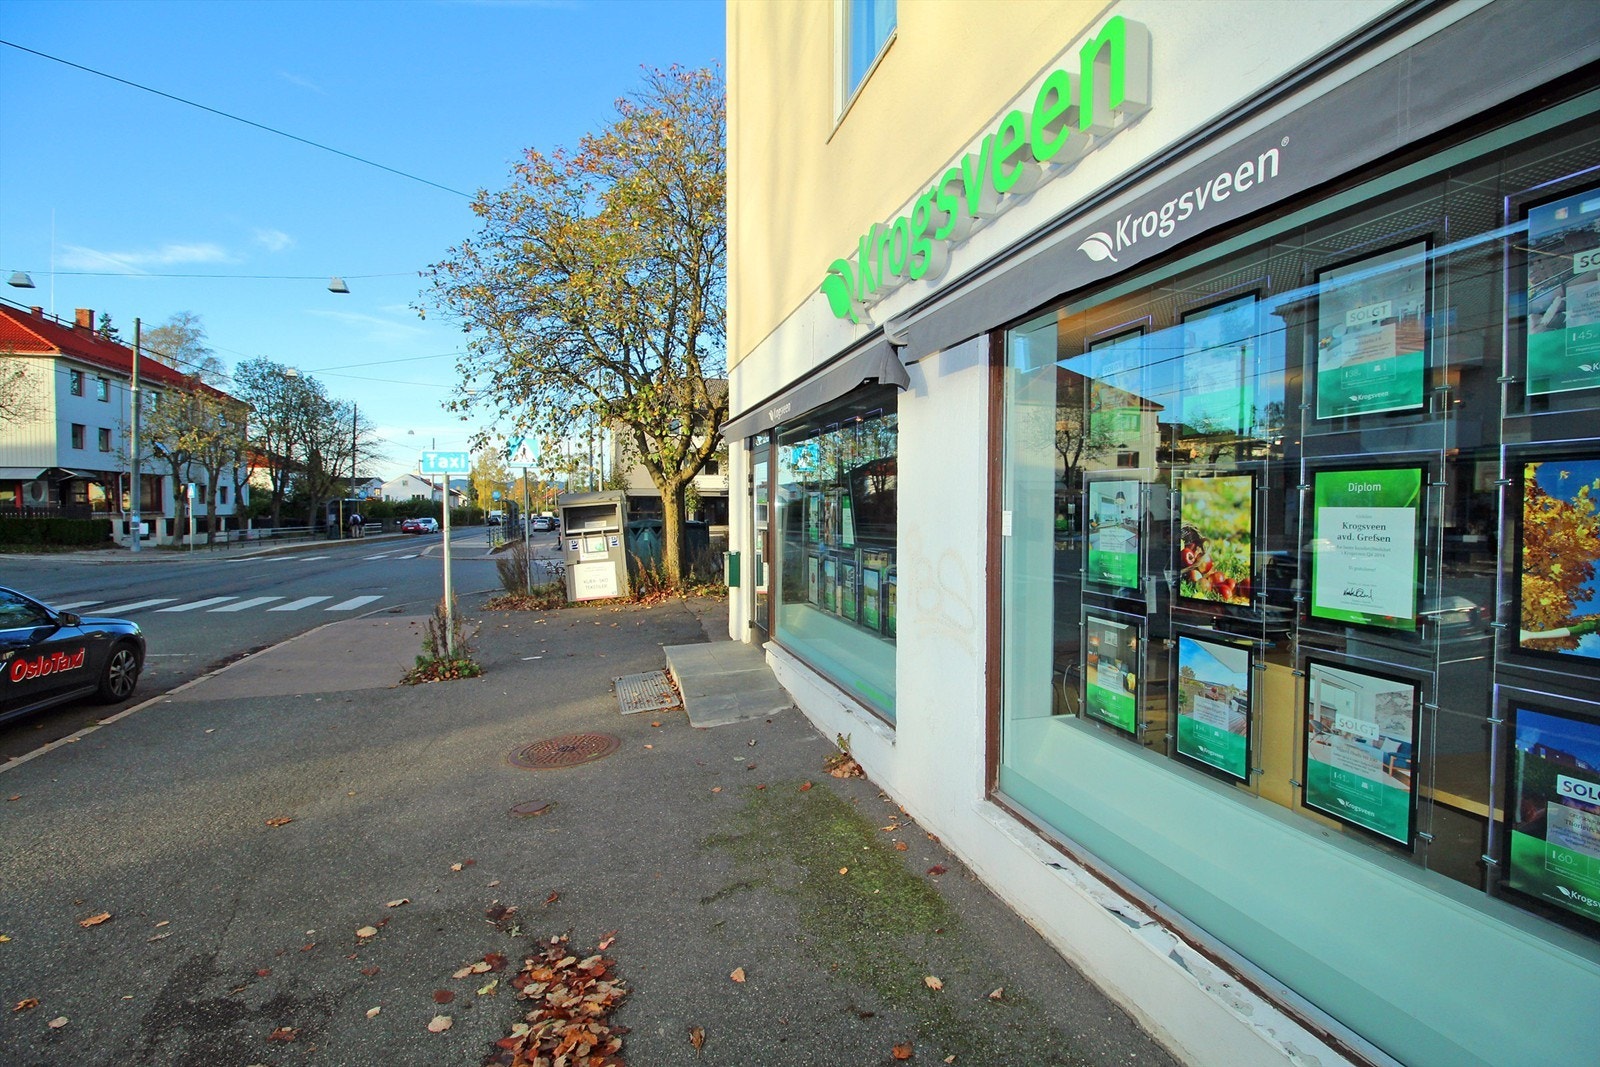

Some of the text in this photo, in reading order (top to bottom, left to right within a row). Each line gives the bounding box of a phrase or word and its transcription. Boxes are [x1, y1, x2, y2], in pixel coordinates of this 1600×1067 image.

[858, 15, 1126, 302] Krogsveen
[1115, 147, 1280, 252] Krogsveen
[1349, 304, 1389, 322] SOLGT
[1357, 391, 1390, 402] Krogsveen
[425, 453, 466, 469] Taxi
[1347, 482, 1382, 494] Diplom
[1342, 521, 1387, 532] Krogsveen
[1336, 532, 1391, 543] avd. Grefsen
[10, 647, 86, 683] OsloTaxi
[1339, 718, 1377, 737] SOLGT
[1562, 780, 1600, 801] SOL
[1344, 799, 1376, 818] Krogsveen
[1557, 852, 1574, 865] 60
